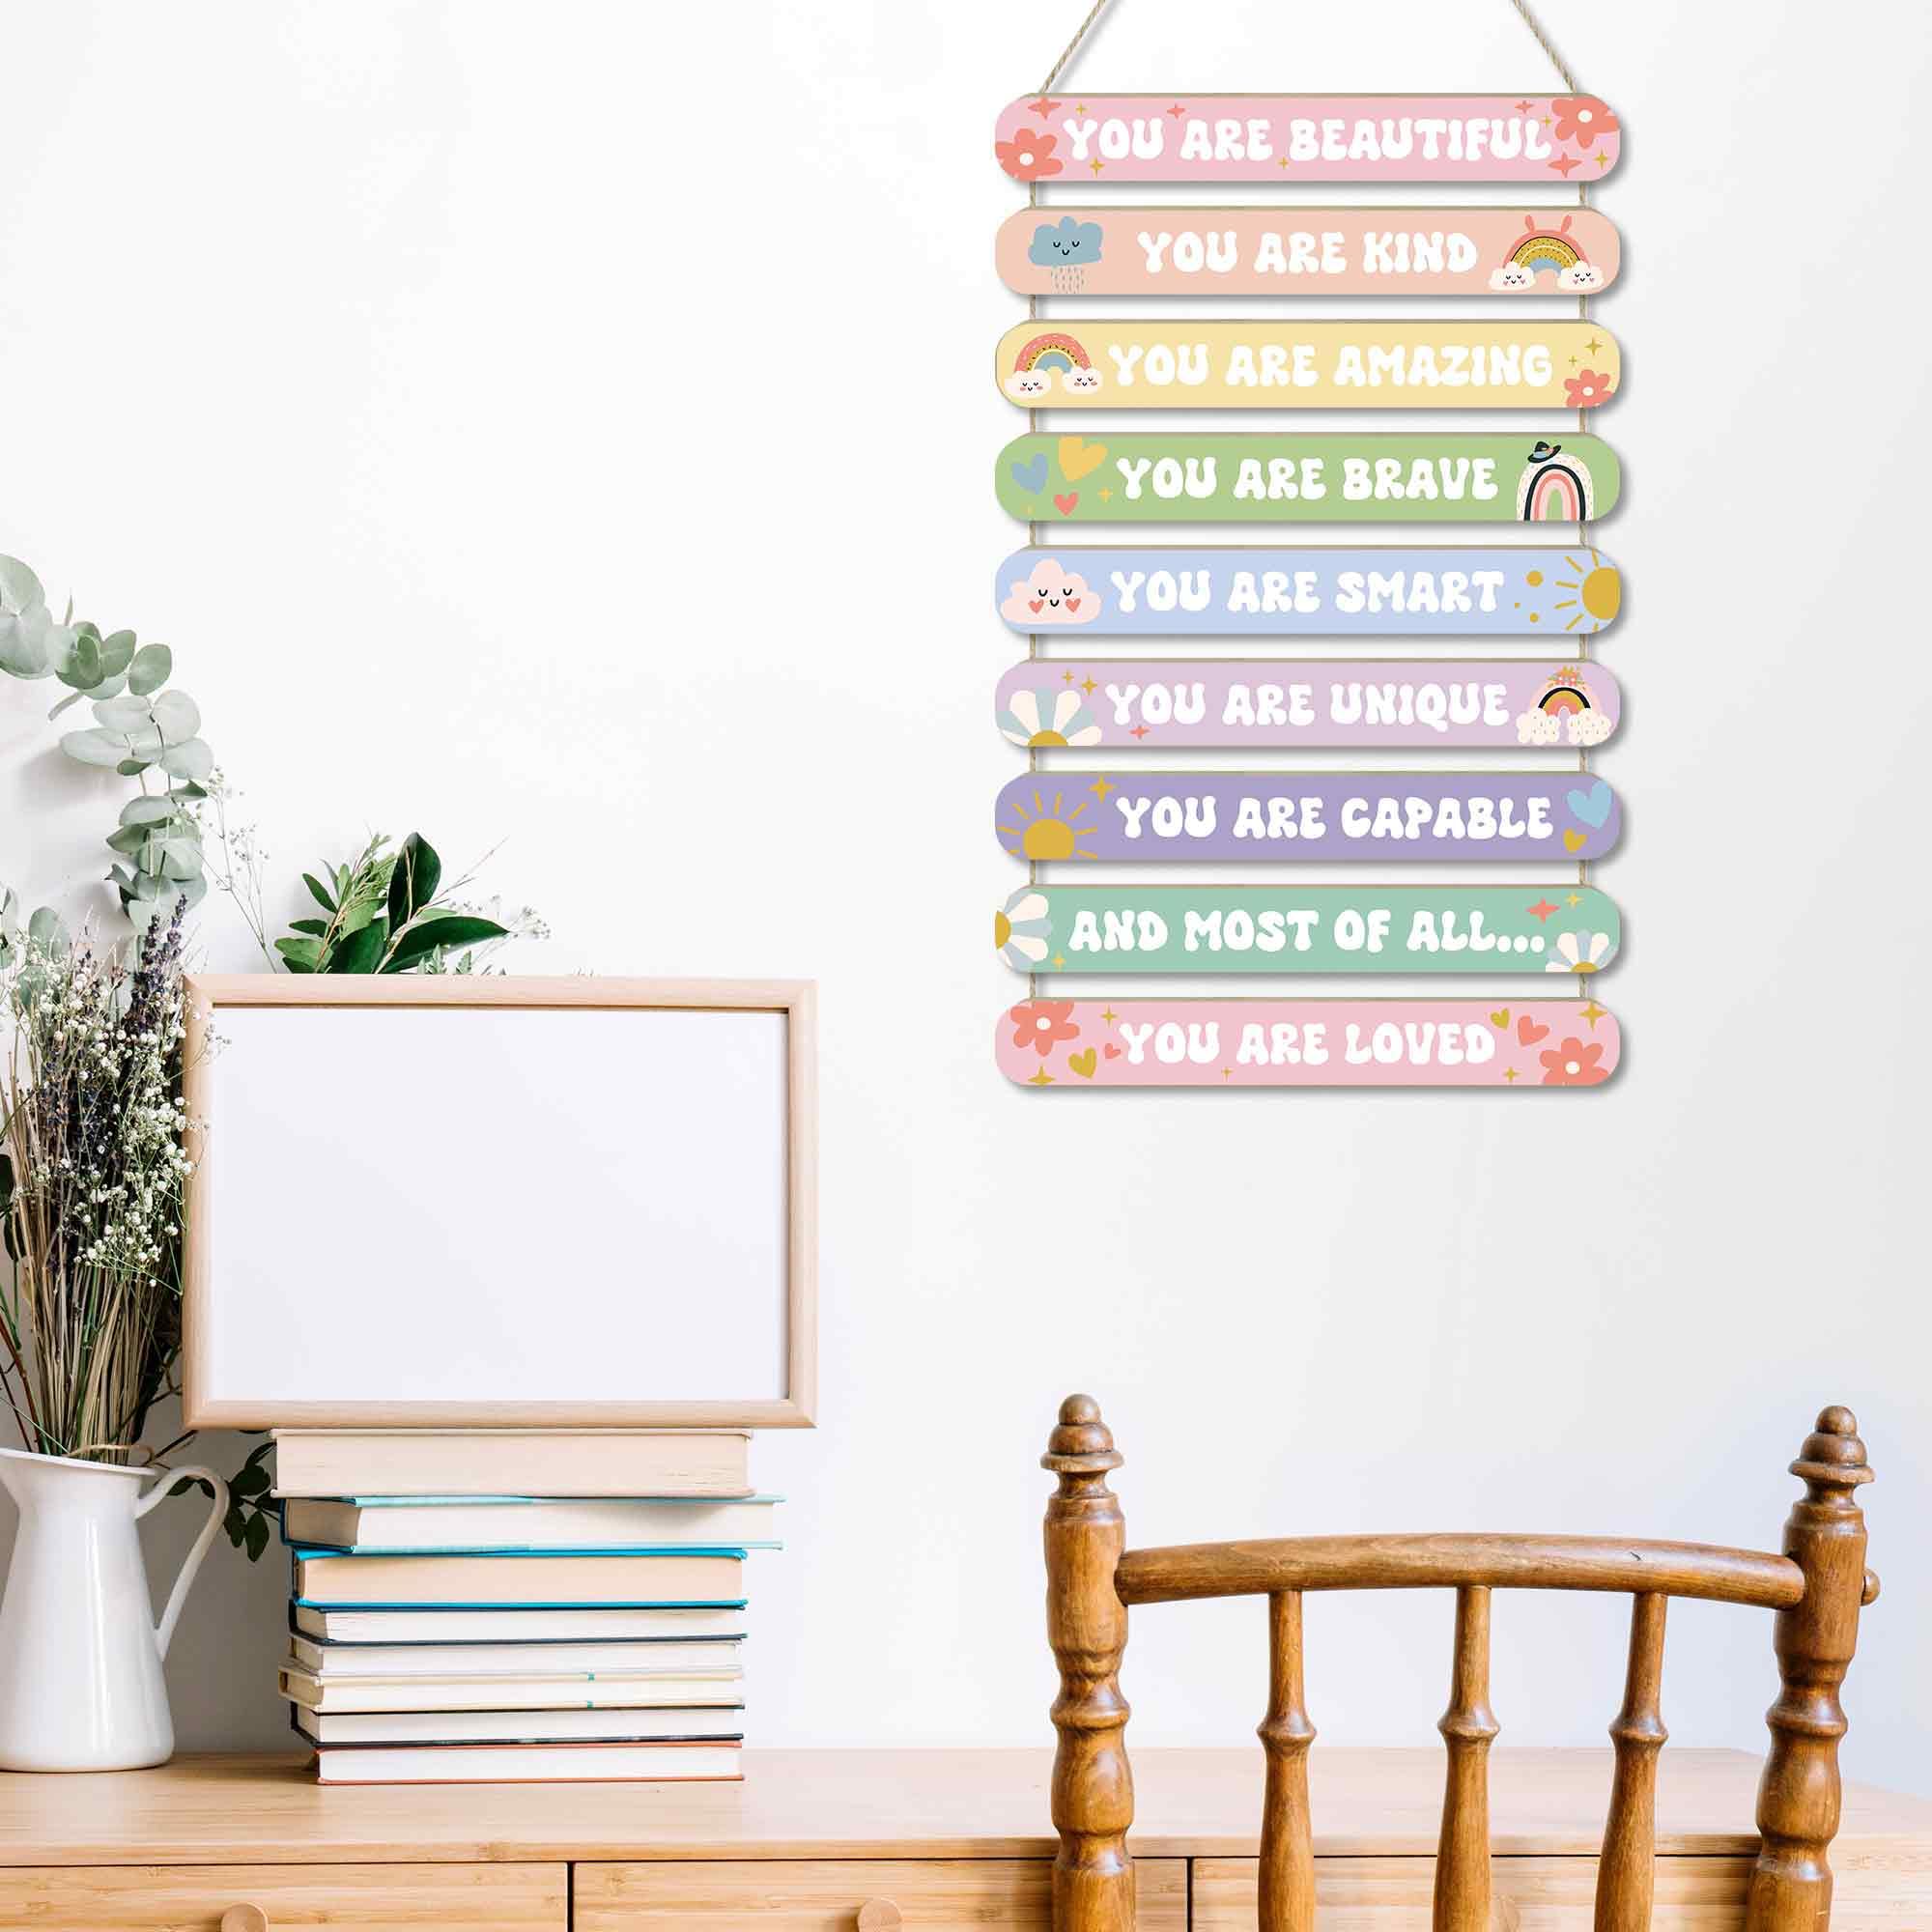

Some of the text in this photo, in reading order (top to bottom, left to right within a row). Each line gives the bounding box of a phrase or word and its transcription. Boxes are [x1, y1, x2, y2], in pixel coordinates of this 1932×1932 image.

[1063, 119, 1551, 161] YOU ARE BEAUTIFUL
[1138, 231, 1478, 273] YOU ARE KIND
[1108, 345, 1551, 387] YOU ARE AMAZING
[1117, 457, 1497, 499] YOU ARE BRAVE
[1111, 570, 1504, 612] YOU ARE SMART
[1105, 683, 1509, 732] YOU ARE UNIQUE
[1116, 796, 1553, 839] YOU ARE CAPABLE
[1068, 910, 1546, 952] AND MOST OF ALL...
[1119, 1022, 1495, 1065] YOU ARE LOVED
